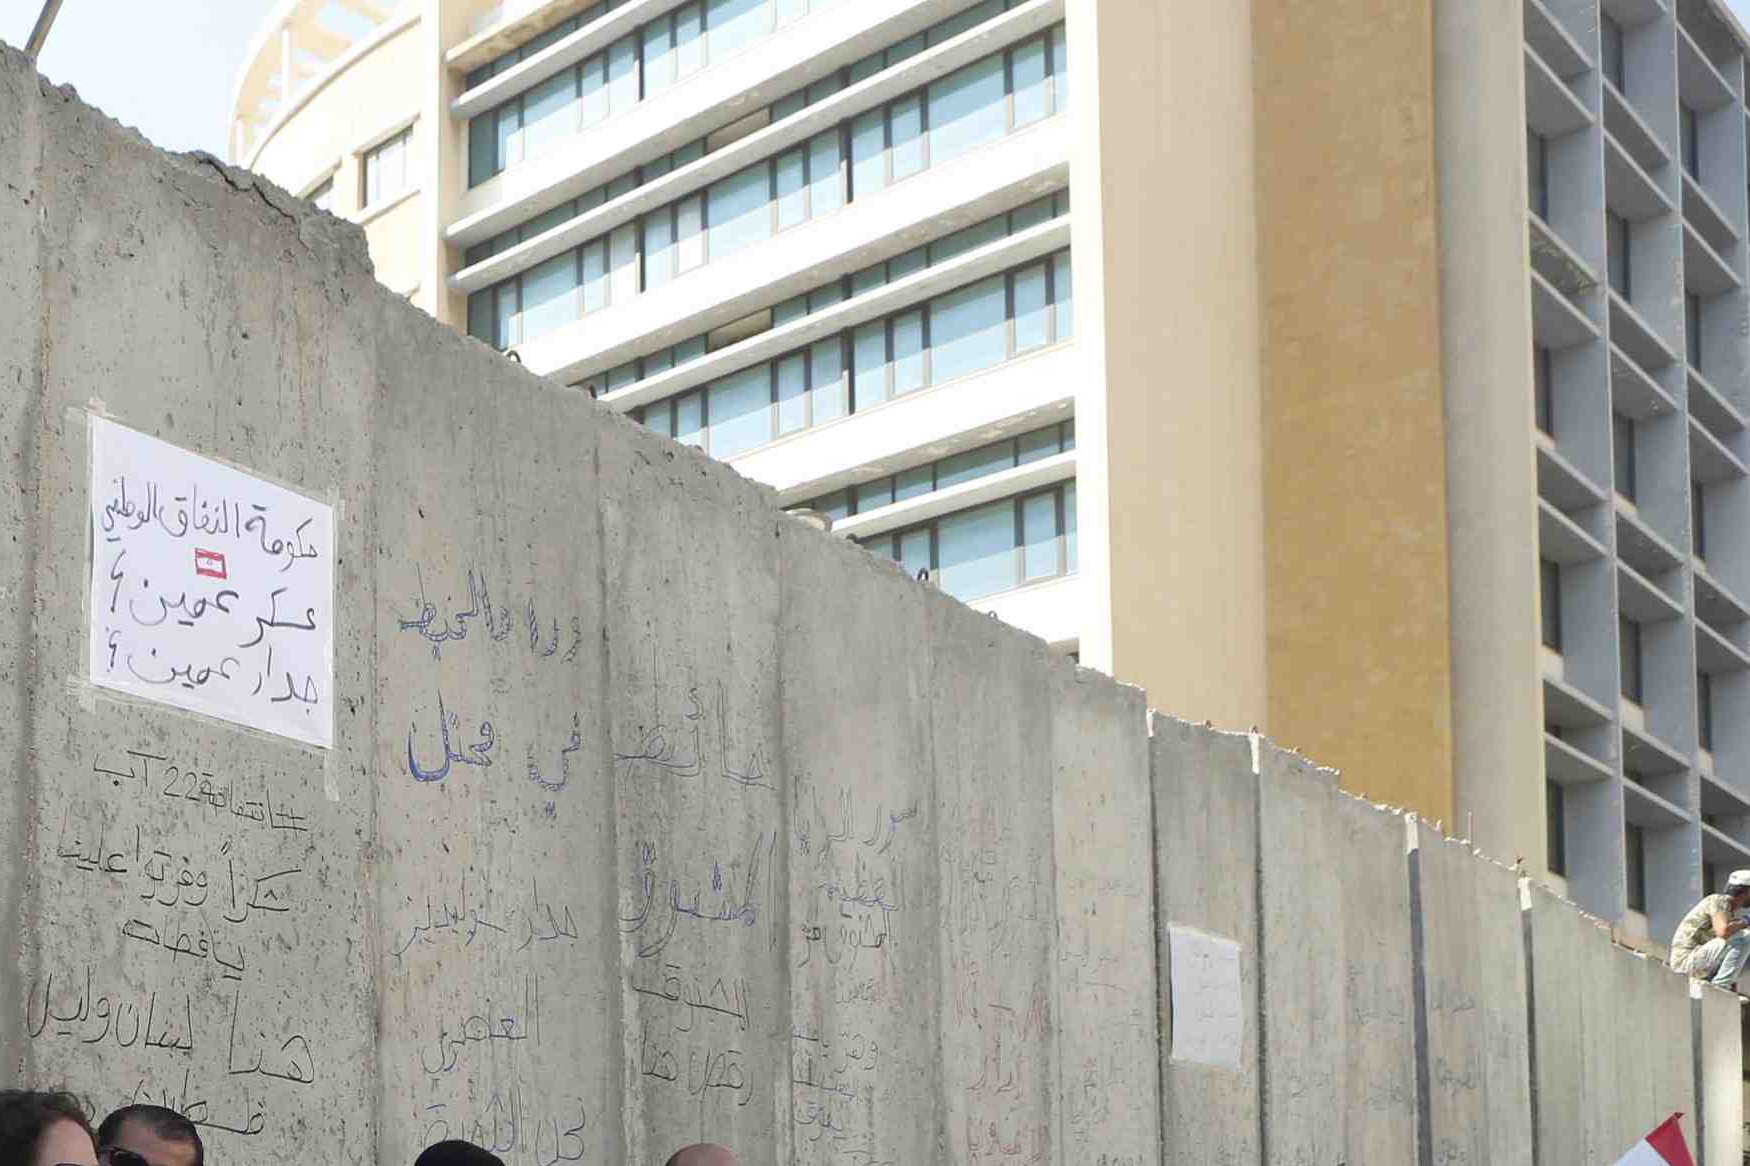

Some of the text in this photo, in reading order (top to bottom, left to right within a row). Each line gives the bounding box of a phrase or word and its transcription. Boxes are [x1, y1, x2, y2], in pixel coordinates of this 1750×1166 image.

[245, 503, 319, 572] حكومة
[251, 643, 319, 715] جدار
[228, 988, 315, 1084] هنا
